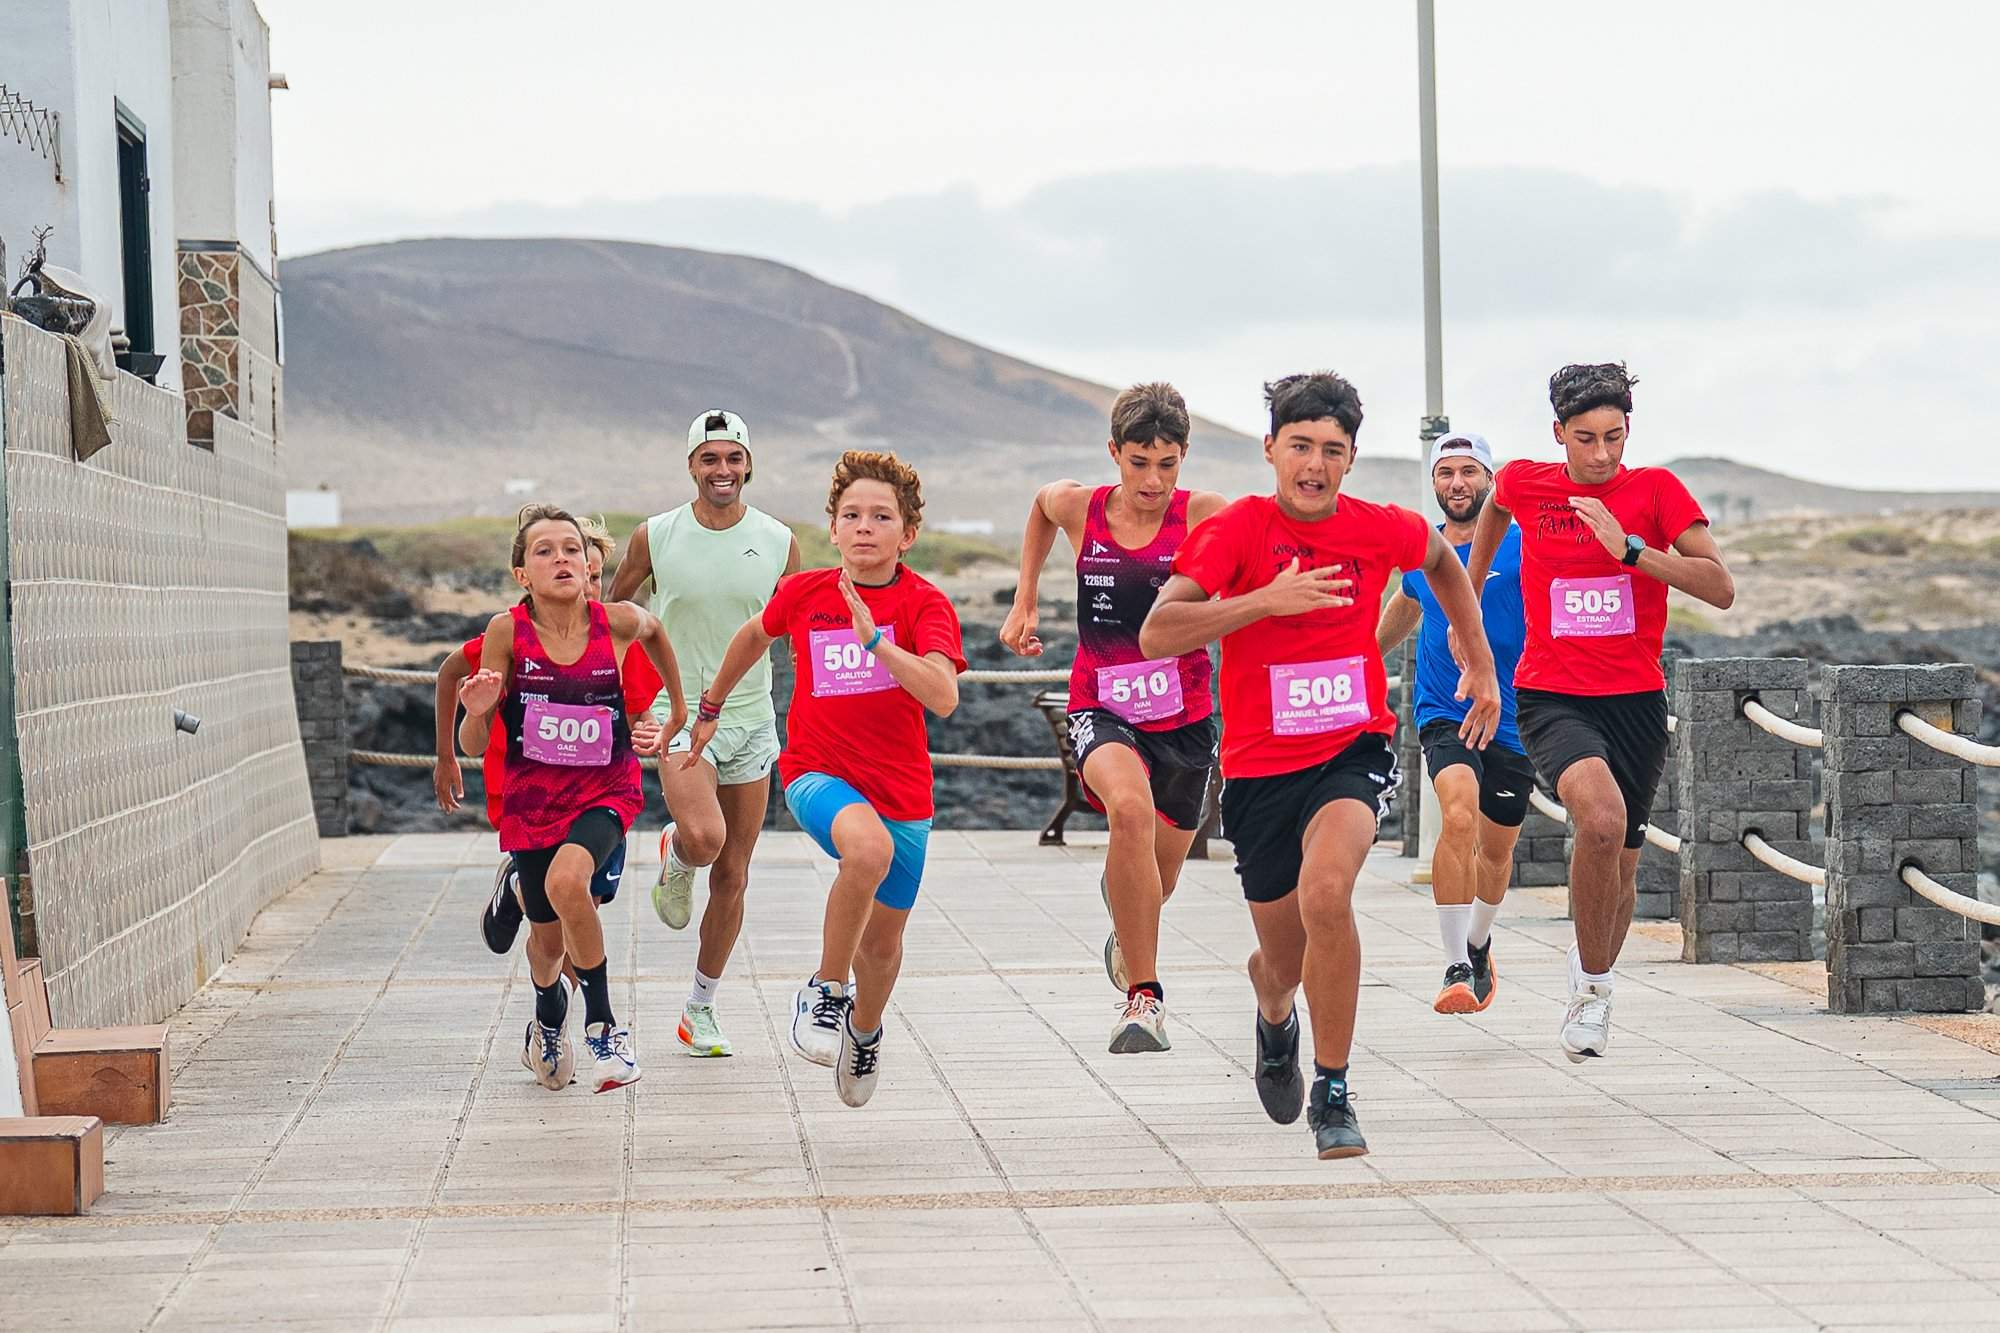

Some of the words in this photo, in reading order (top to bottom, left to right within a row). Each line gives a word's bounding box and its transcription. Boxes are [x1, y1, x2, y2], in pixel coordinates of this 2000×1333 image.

[1084, 574, 1115, 587] 226ERS
[1564, 589, 1621, 614] 505
[1576, 615, 1612, 623] ESTRADA
[824, 643, 876, 671] 507
[835, 671, 873, 680] CARLITOS
[1111, 671, 1169, 702] 510
[1288, 673, 1353, 708] 508
[538, 715, 600, 744] 500
[556, 743, 579, 752] GAEL
